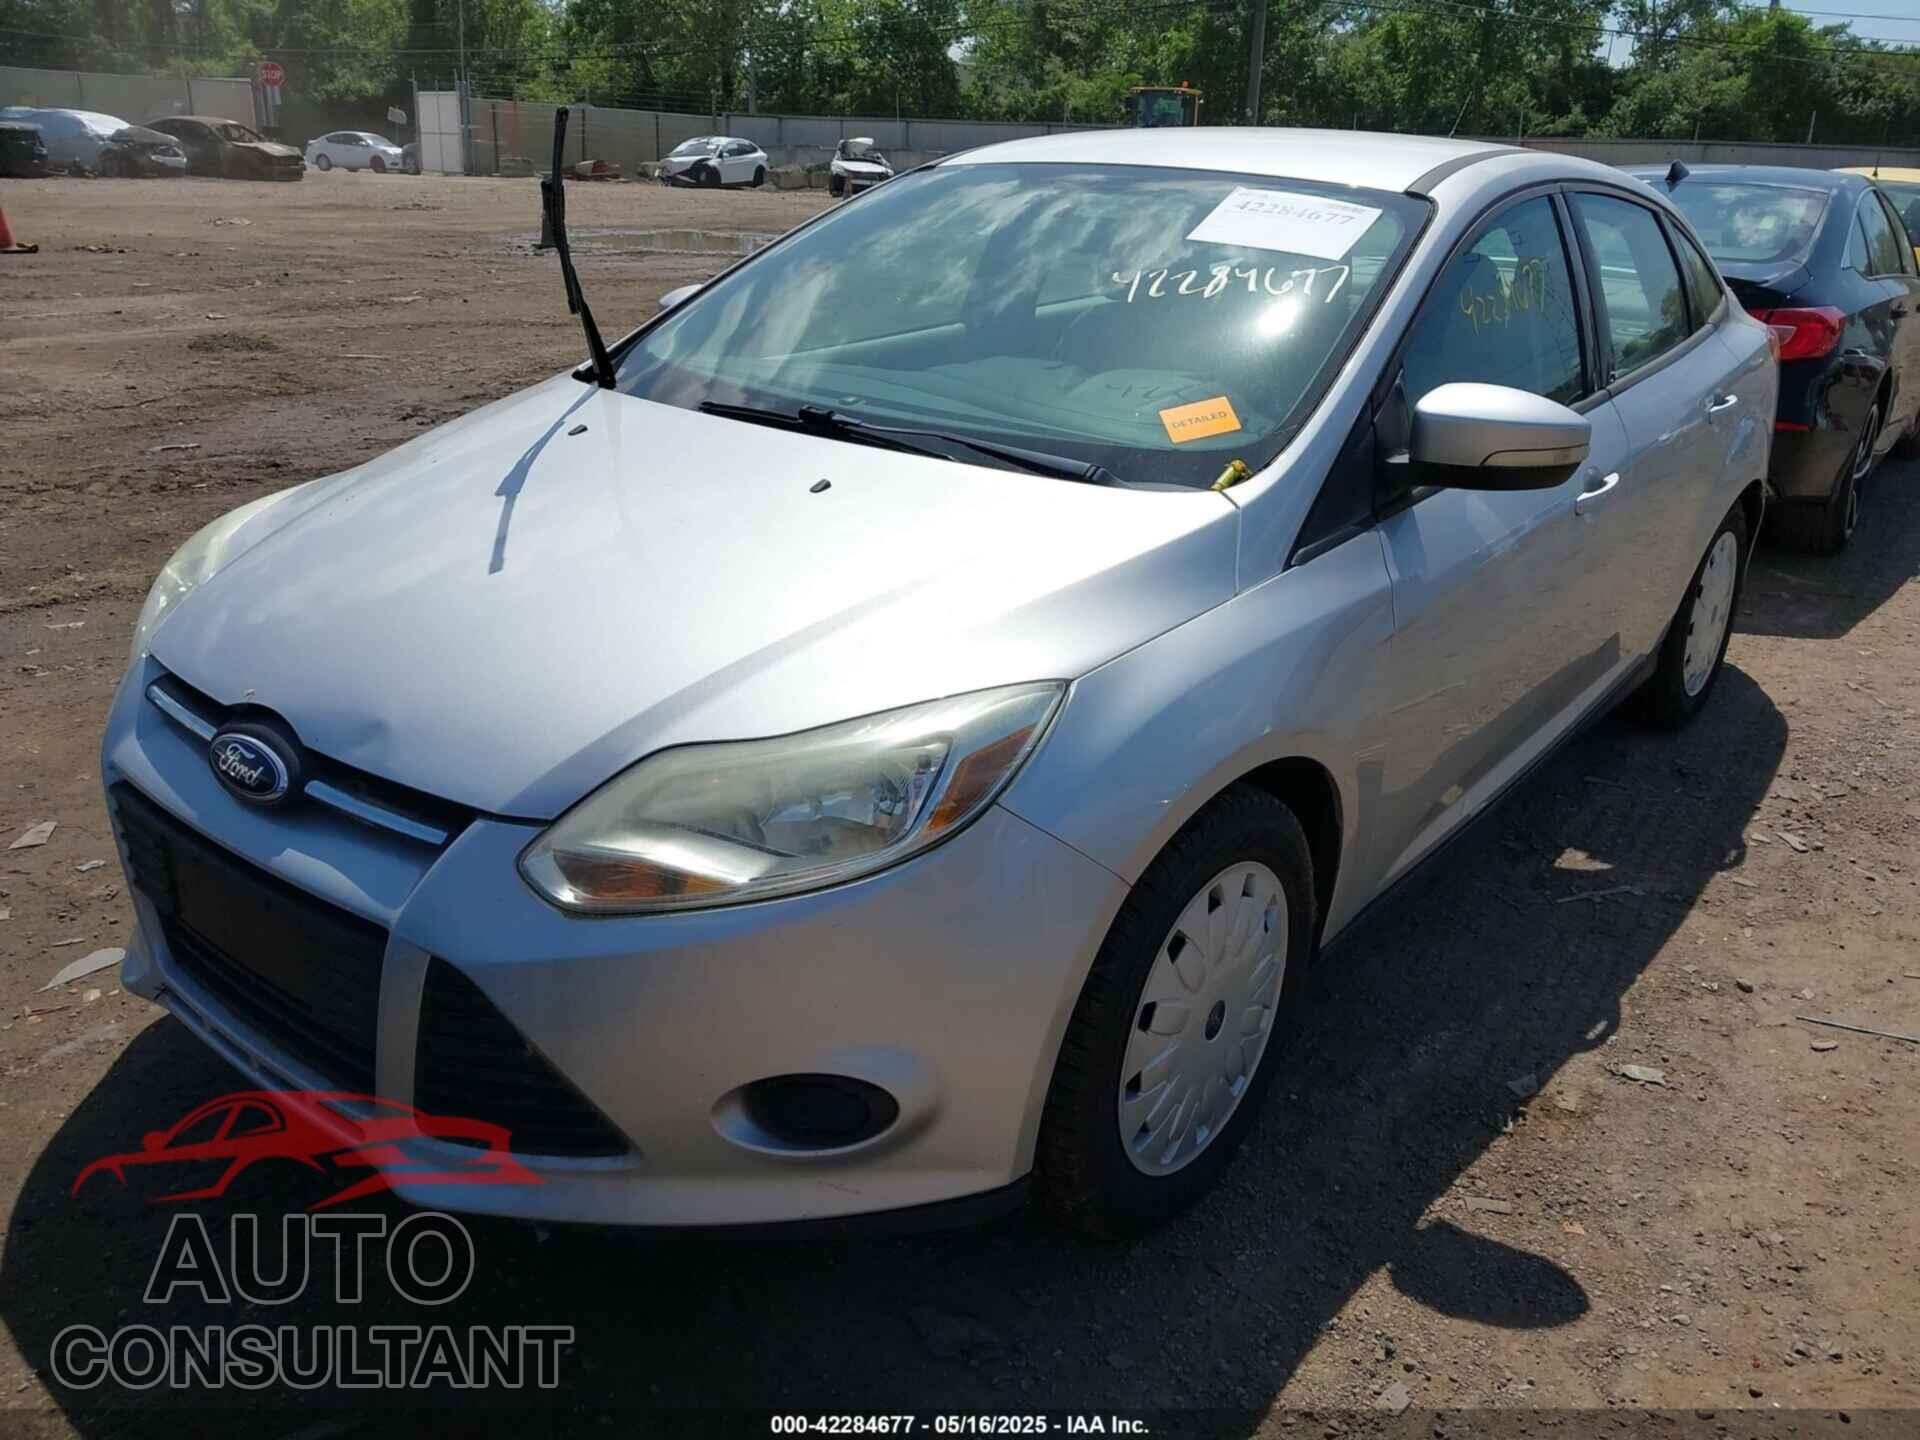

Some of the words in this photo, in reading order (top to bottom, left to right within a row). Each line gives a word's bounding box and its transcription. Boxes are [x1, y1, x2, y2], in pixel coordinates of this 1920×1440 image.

[261, 69, 282, 81] STOP
[1112, 265, 1350, 303] 42284677
[1171, 410, 1228, 430] DETAILED
[215, 742, 265, 787] Ford
